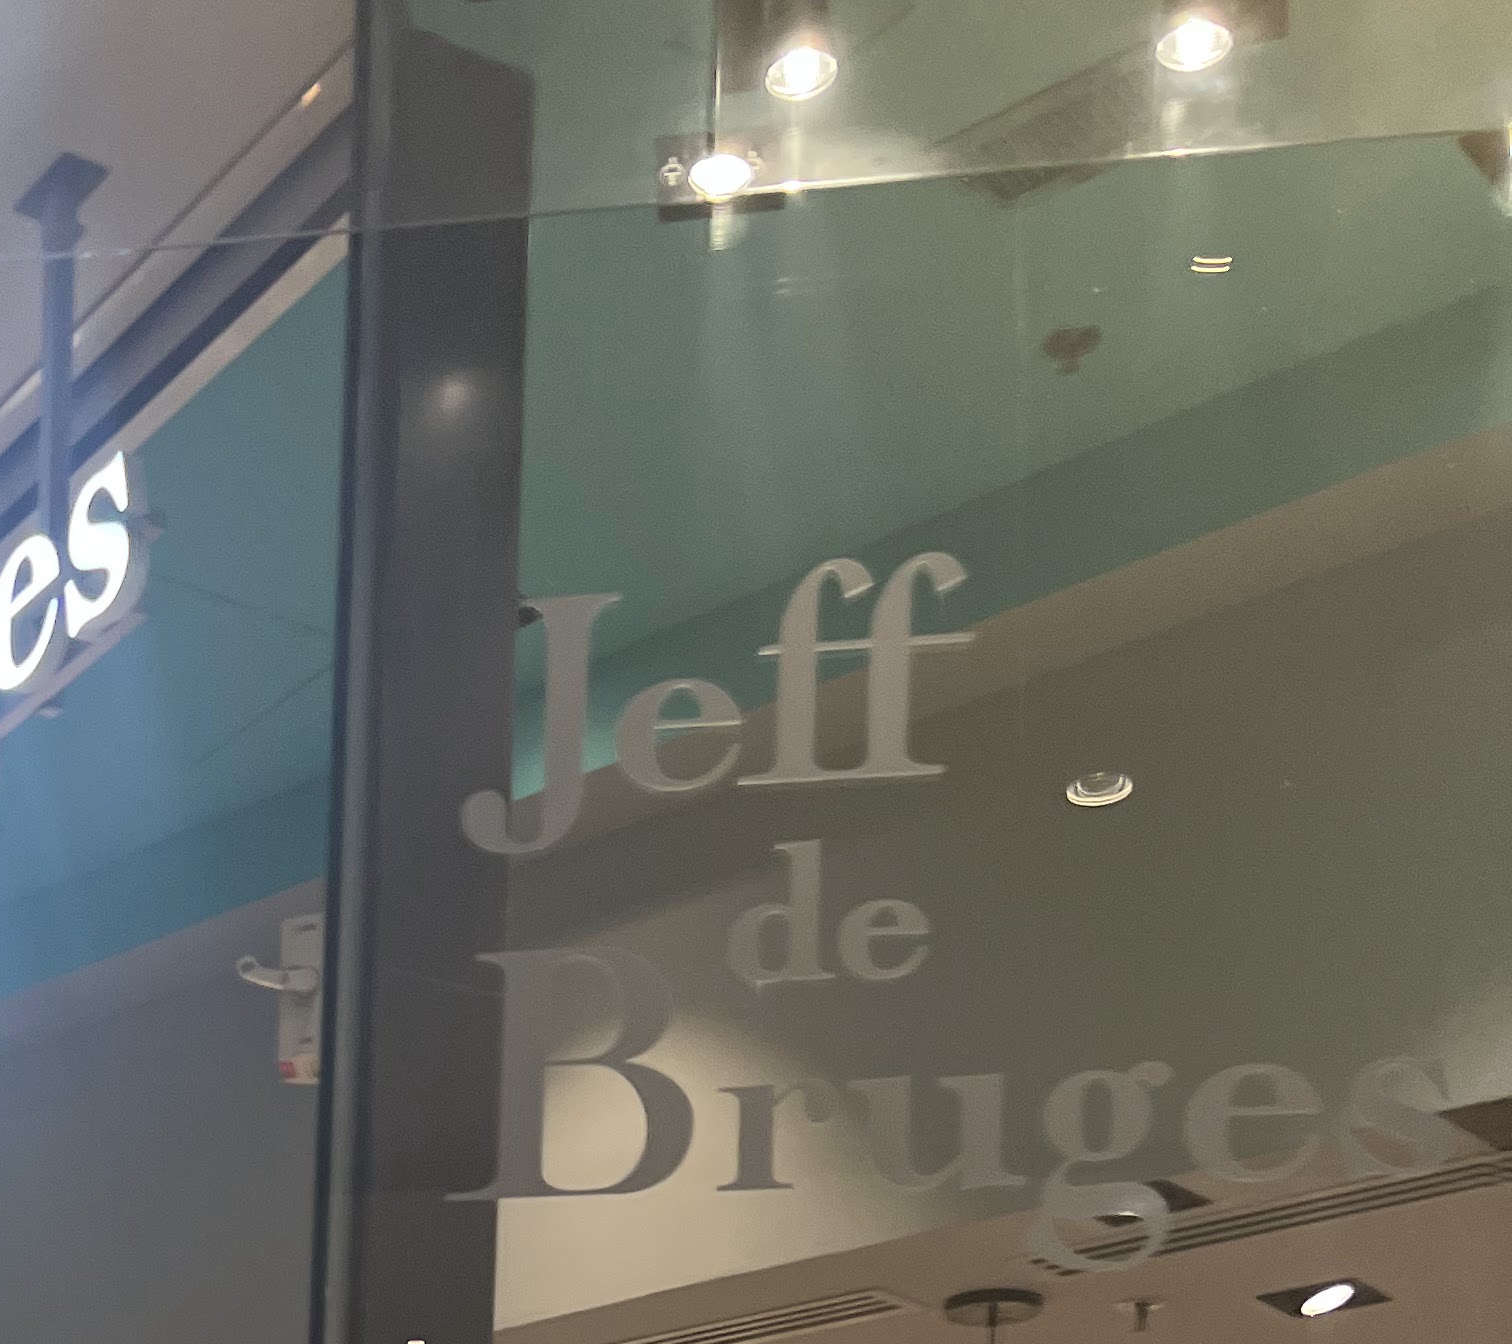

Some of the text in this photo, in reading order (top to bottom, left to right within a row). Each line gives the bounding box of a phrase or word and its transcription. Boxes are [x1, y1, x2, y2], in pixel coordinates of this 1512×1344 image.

[461, 550, 975, 854] Jeff
[727, 839, 930, 988] de
[444, 945, 1448, 1273] Bruges
